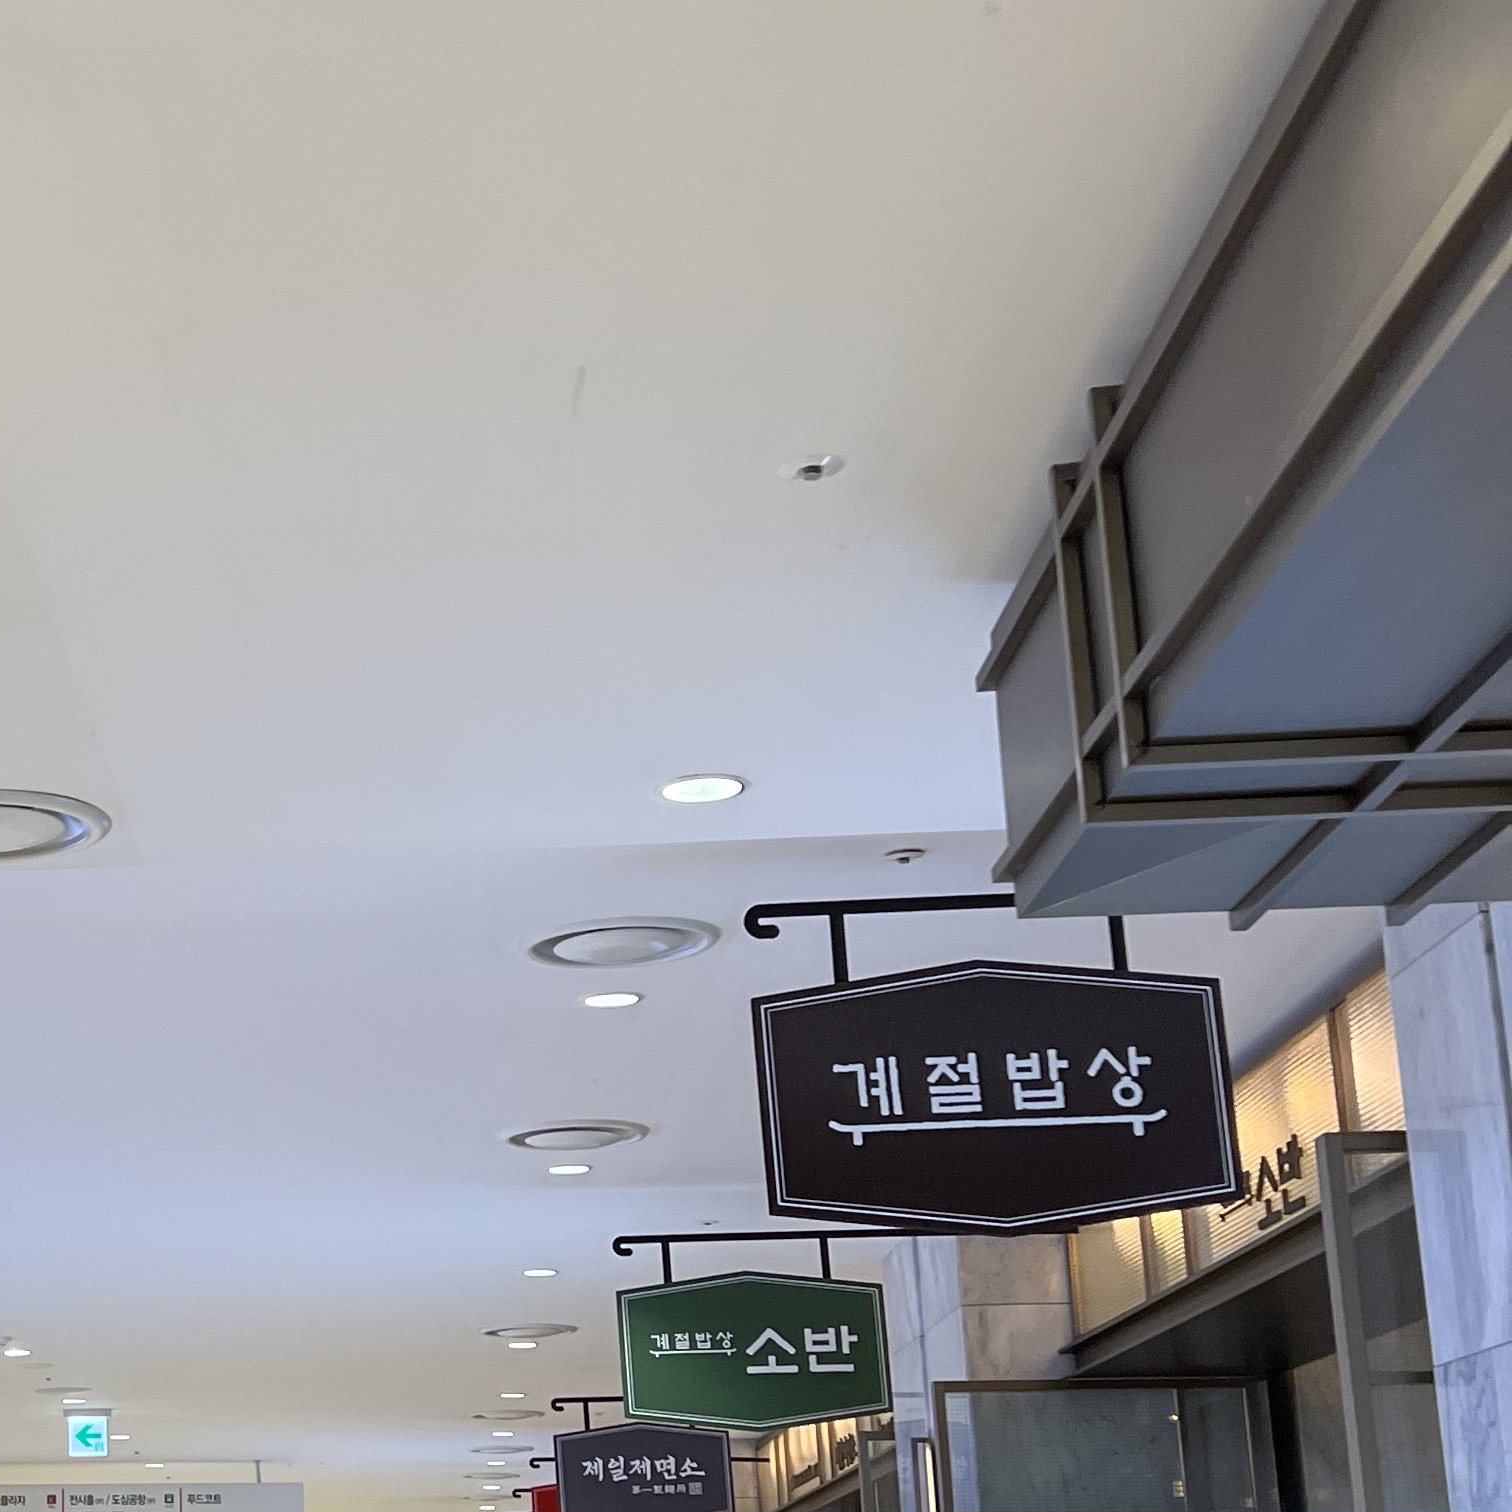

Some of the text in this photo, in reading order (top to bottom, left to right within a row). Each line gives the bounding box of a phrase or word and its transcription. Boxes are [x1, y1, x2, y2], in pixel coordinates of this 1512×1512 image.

[832, 1046, 1152, 1118] 계절밥상
[1256, 1133, 1306, 1230] 소반
[650, 1325, 858, 1375] 계절밥상 소반
[581, 1454, 706, 1482] 제일제면소
[112, 1494, 147, 1506] 도심공항
[187, 1493, 222, 1505] 푸드코트
